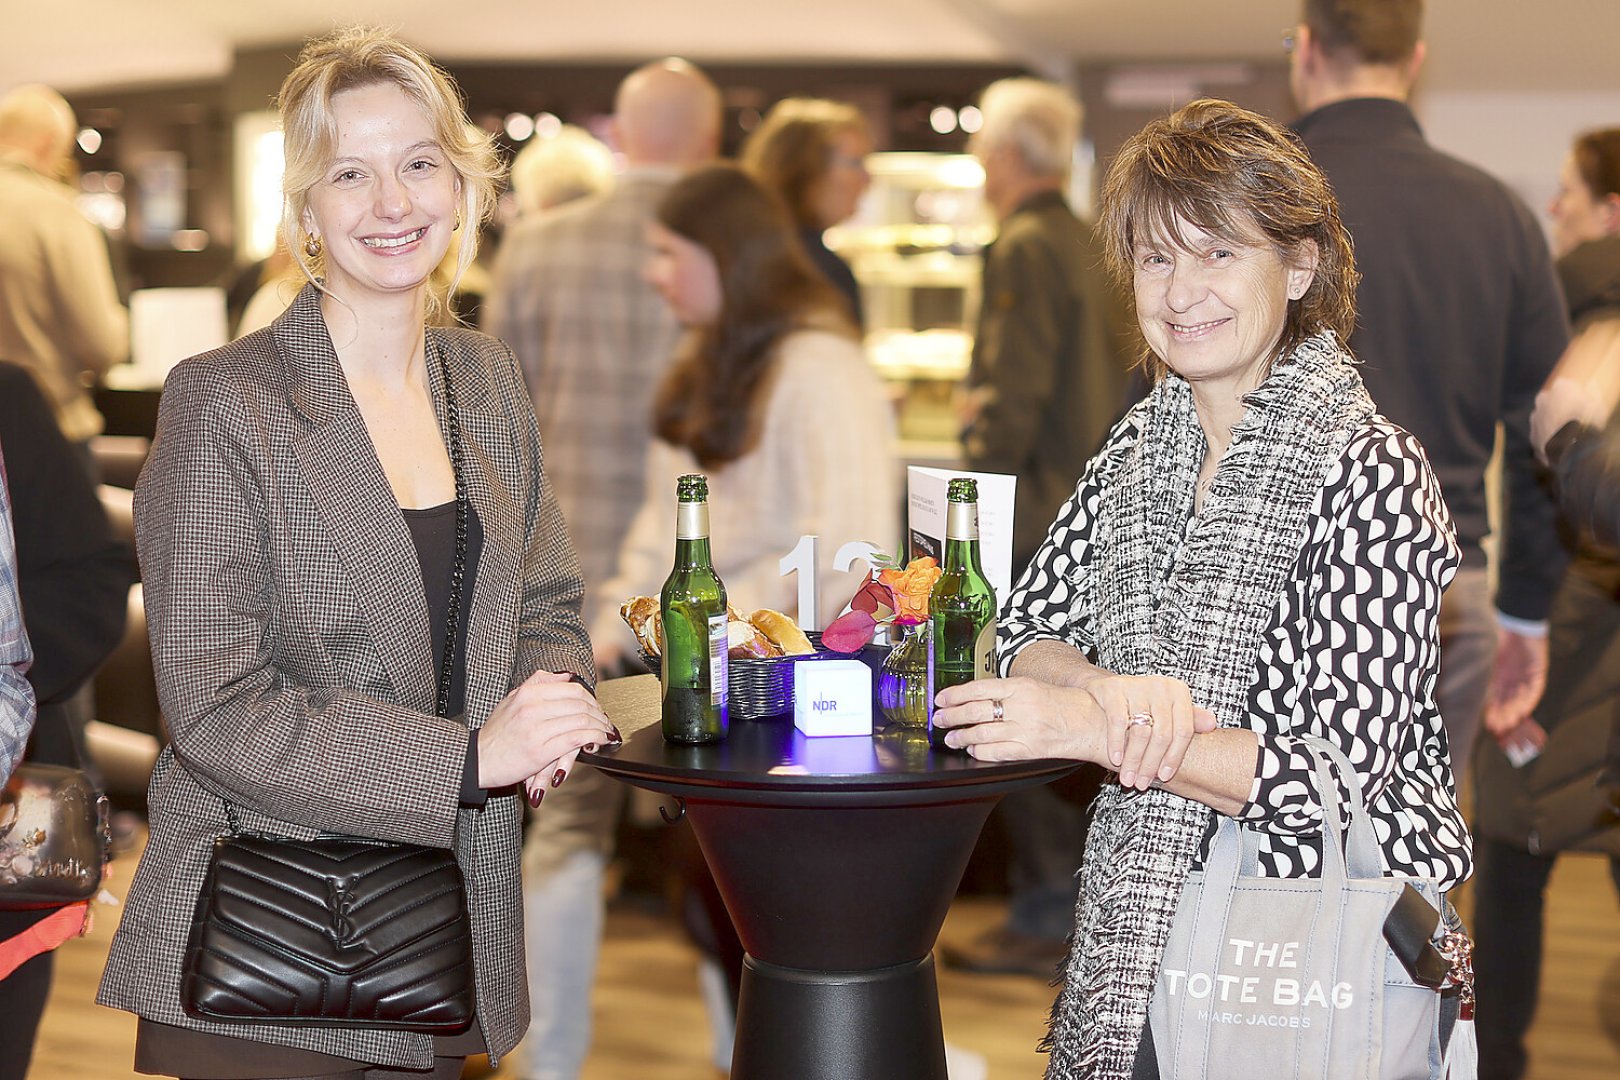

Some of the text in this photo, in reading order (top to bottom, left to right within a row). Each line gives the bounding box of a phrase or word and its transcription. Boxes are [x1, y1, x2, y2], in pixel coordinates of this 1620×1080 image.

[812, 700, 838, 711] NDR
[1228, 938, 1300, 969] THE
[1163, 968, 1354, 1010] TOTE BAG
[1197, 1009, 1312, 1029] MARC JACOBS
